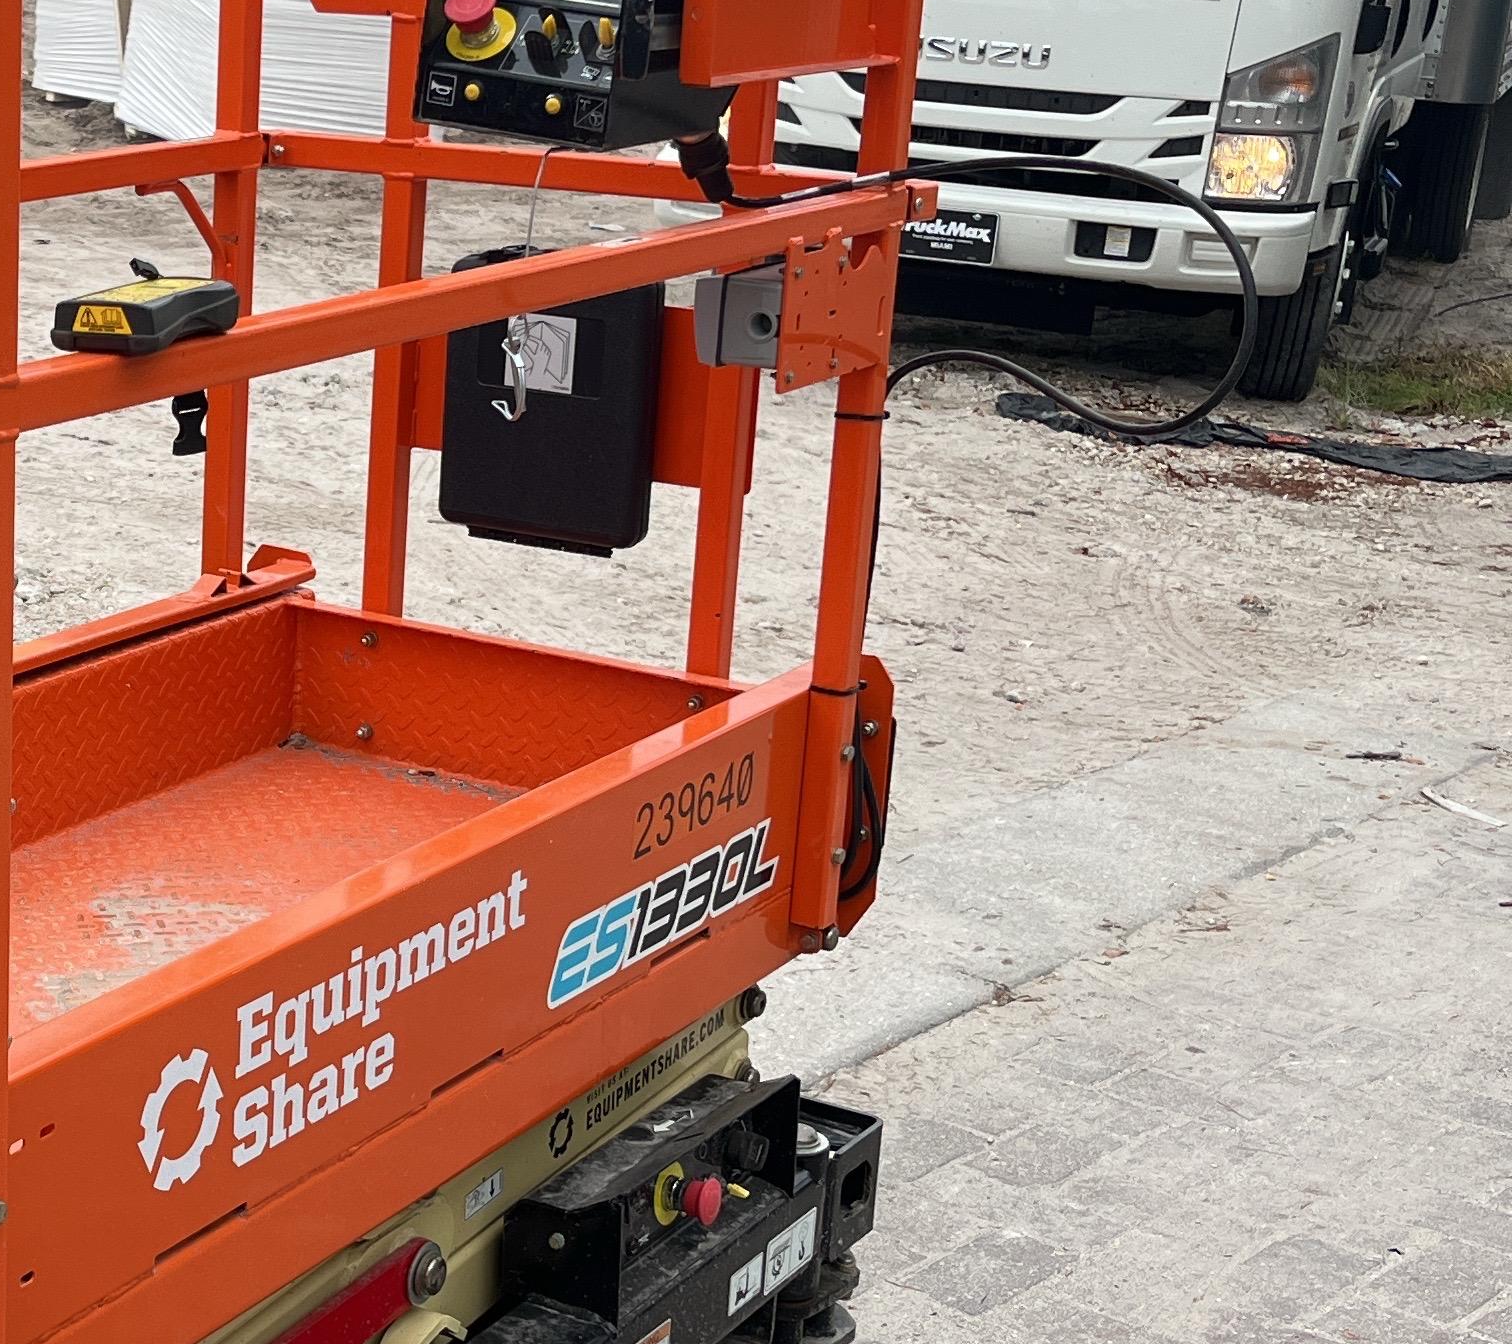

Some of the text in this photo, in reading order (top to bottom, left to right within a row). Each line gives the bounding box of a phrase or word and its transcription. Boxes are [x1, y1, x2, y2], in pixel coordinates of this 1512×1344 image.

[901, 218, 991, 243] ruckMax
[634, 751, 755, 860] 239640
[235, 869, 528, 1079] Equipment
[548, 817, 780, 1010] ES1330L
[232, 1032, 395, 1168] Share
[586, 1008, 725, 1131] EQUIPMENTSHARE.COM
